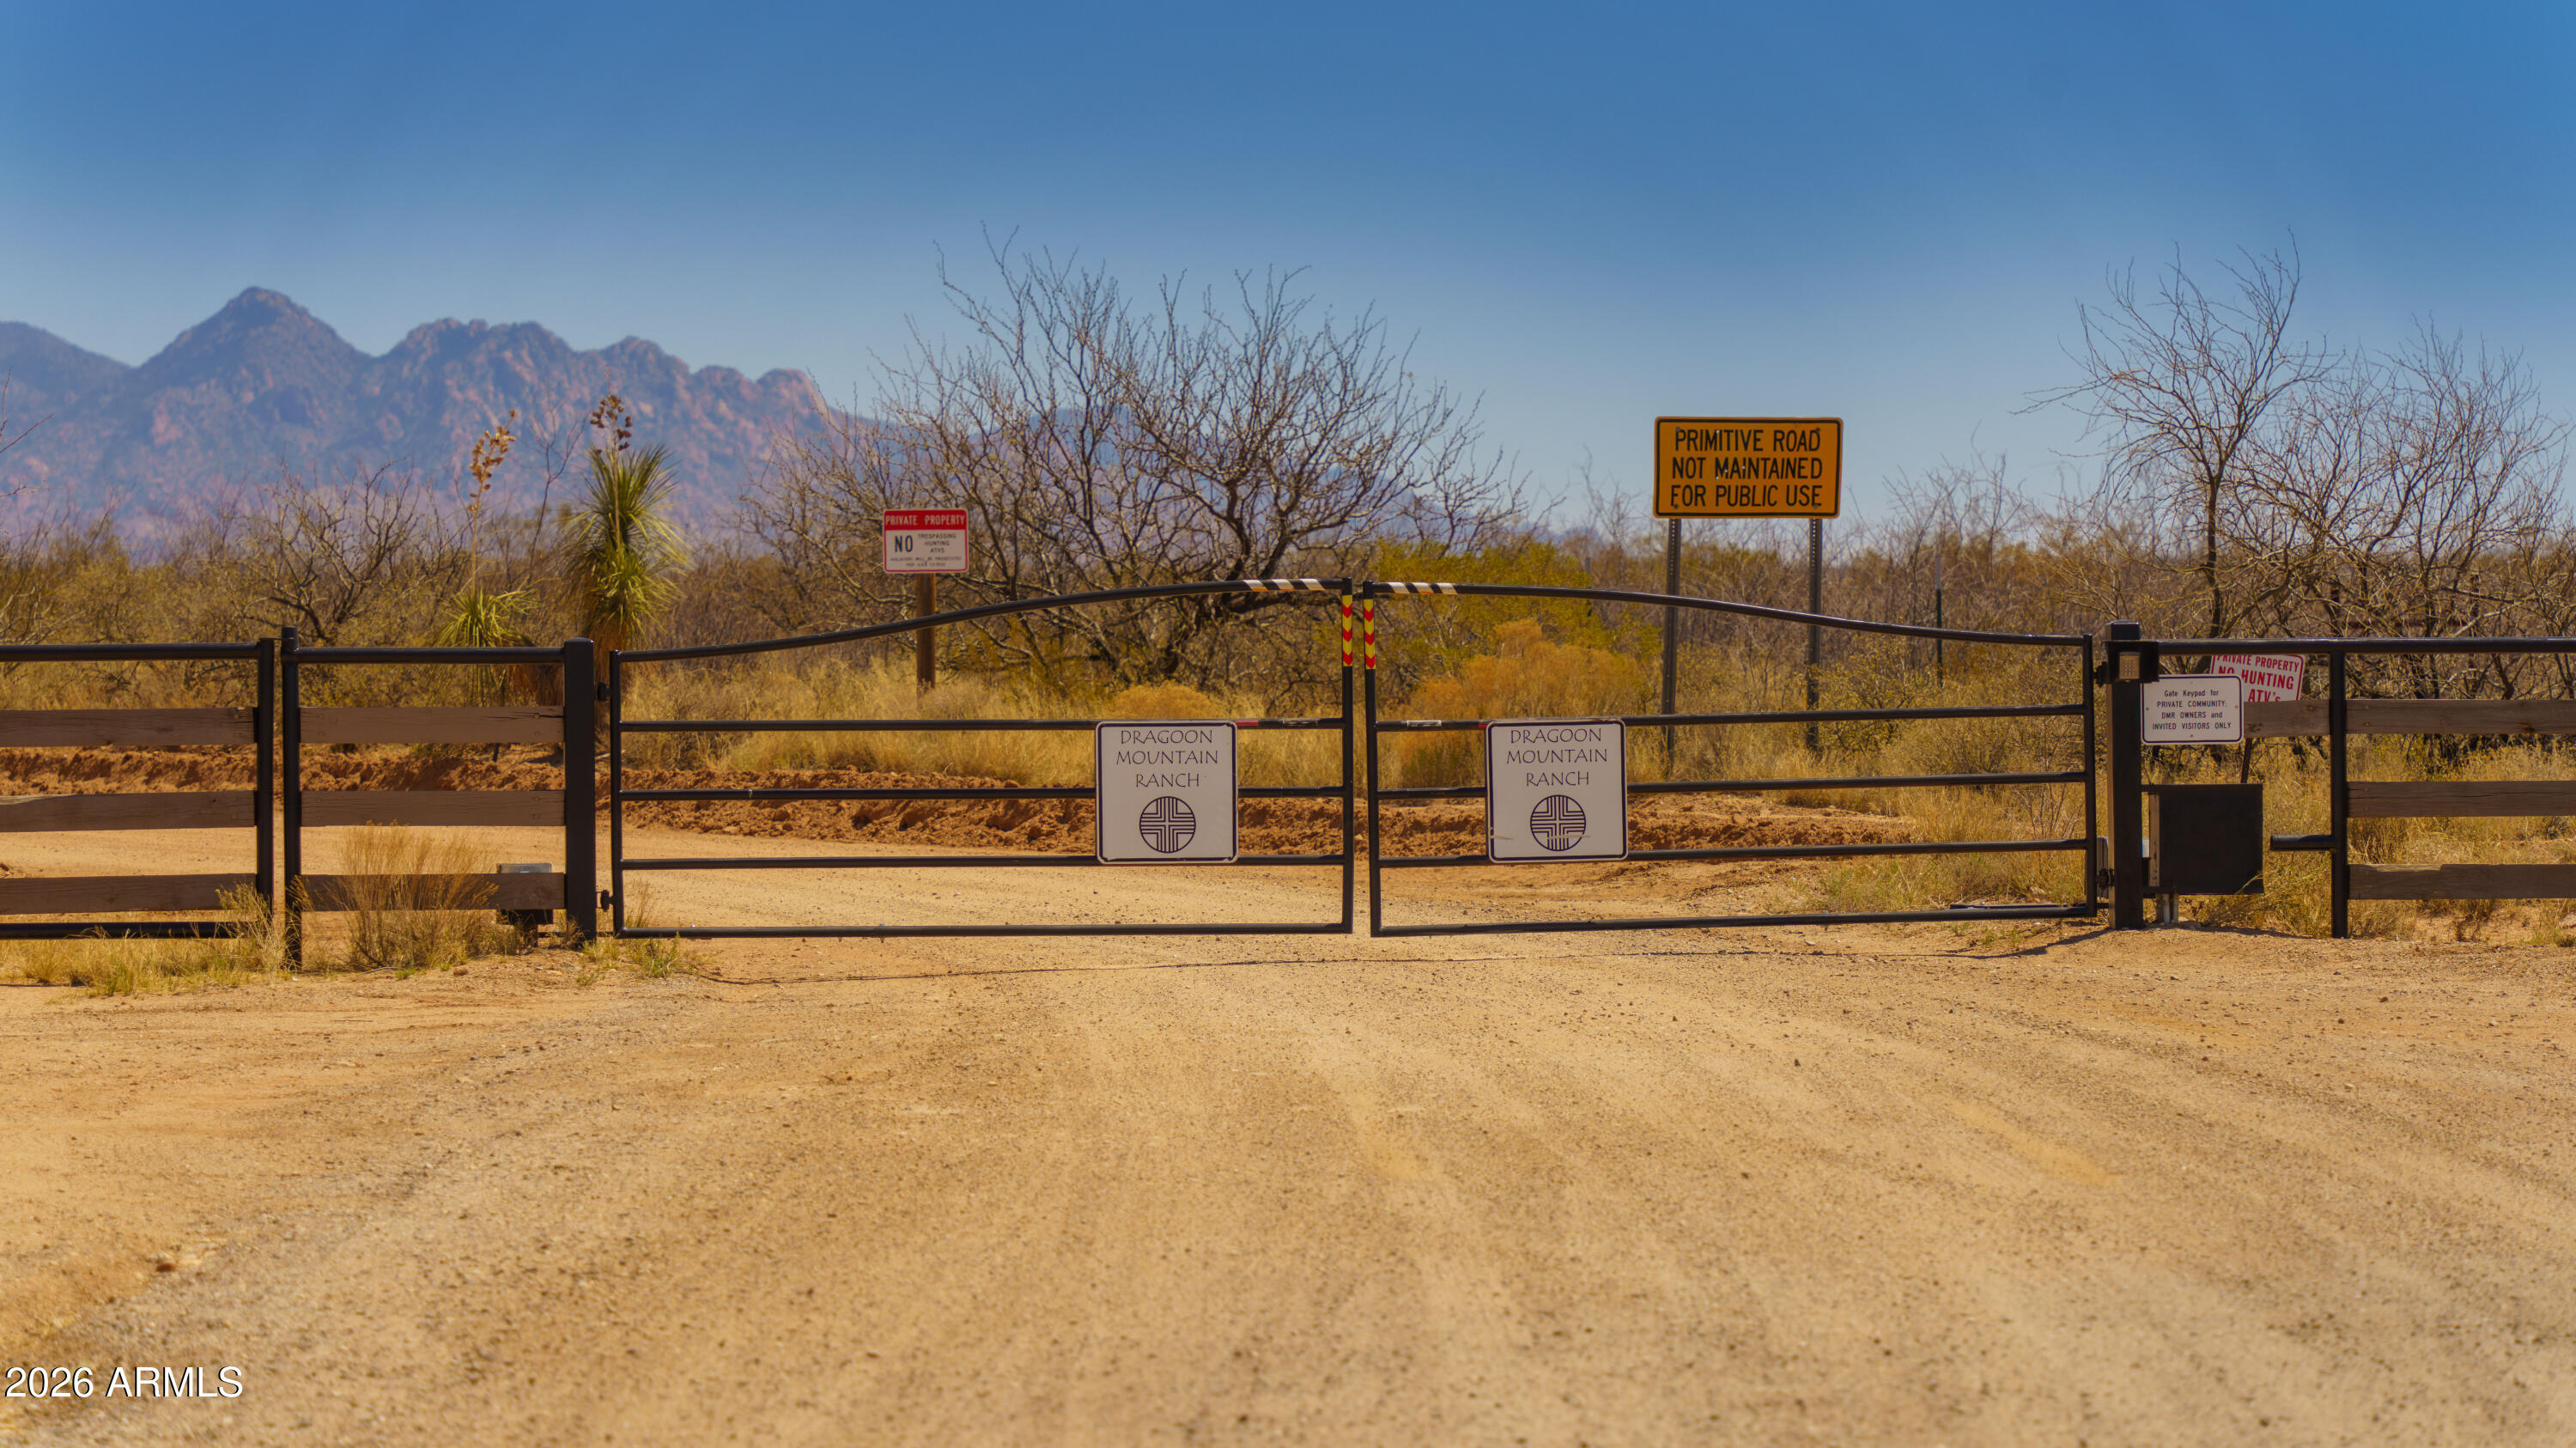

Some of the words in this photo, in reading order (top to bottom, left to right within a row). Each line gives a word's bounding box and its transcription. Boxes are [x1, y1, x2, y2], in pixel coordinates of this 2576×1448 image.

[1675, 429, 1764, 452] PRIMITIVE
[1773, 429, 1820, 453] ROAD
[1672, 457, 1706, 479] NOT
[1715, 457, 1823, 479] MAINTAINED
[1671, 484, 1706, 507] FOR
[1716, 484, 1778, 507] PUBLIC
[1786, 484, 1823, 507] USE
[885, 515, 918, 526] PRIVATE
[924, 514, 965, 526] PROPERTY
[895, 535, 914, 552] NO
[2255, 656, 2300, 672] PROPERTY
[2241, 669, 2294, 690] HUNTING
[2183, 690, 2206, 698] Keypad
[1121, 730, 1212, 745] DRAGOON
[1510, 728, 1601, 744] DRAGOON
[1116, 751, 1218, 764] MOUNTAIN
[1506, 748, 1607, 764] MOUNTAIN
[1136, 773, 1200, 788] RANCH
[1526, 771, 1589, 787] RANCH
